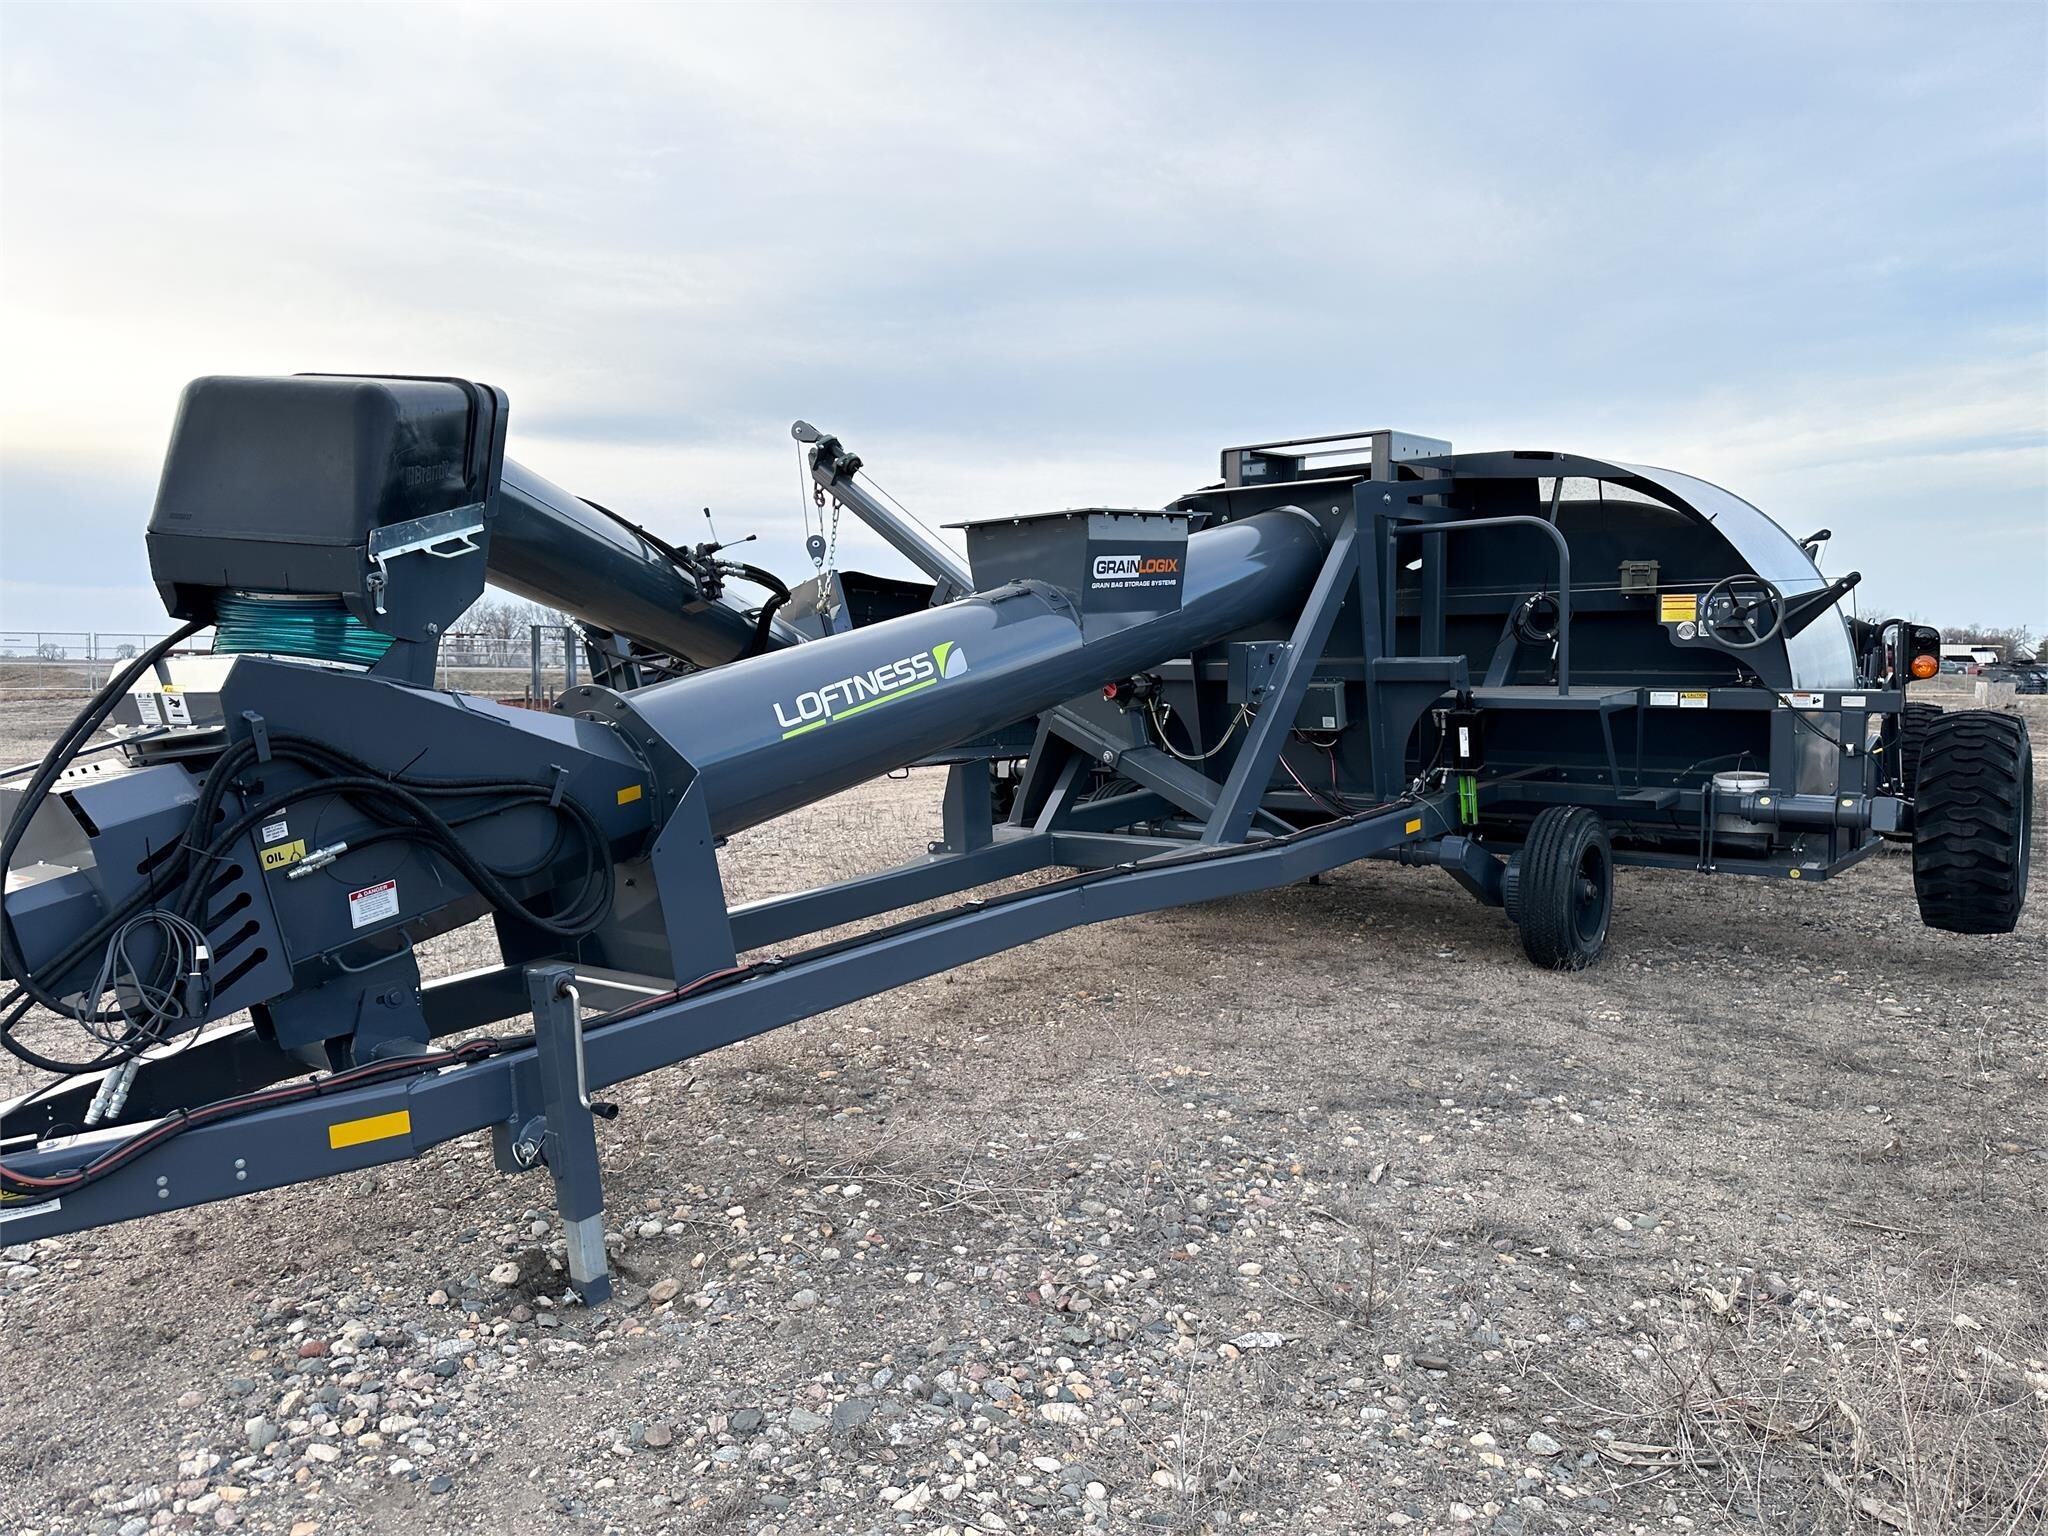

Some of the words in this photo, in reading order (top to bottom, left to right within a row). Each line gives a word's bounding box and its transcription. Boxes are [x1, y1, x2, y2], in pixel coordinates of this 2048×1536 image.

[1151, 579, 1176, 587] SYSTEMS
[773, 651, 934, 728] LOFTNESS
[266, 851, 284, 865] OIL
[363, 884, 388, 897] DANGER
